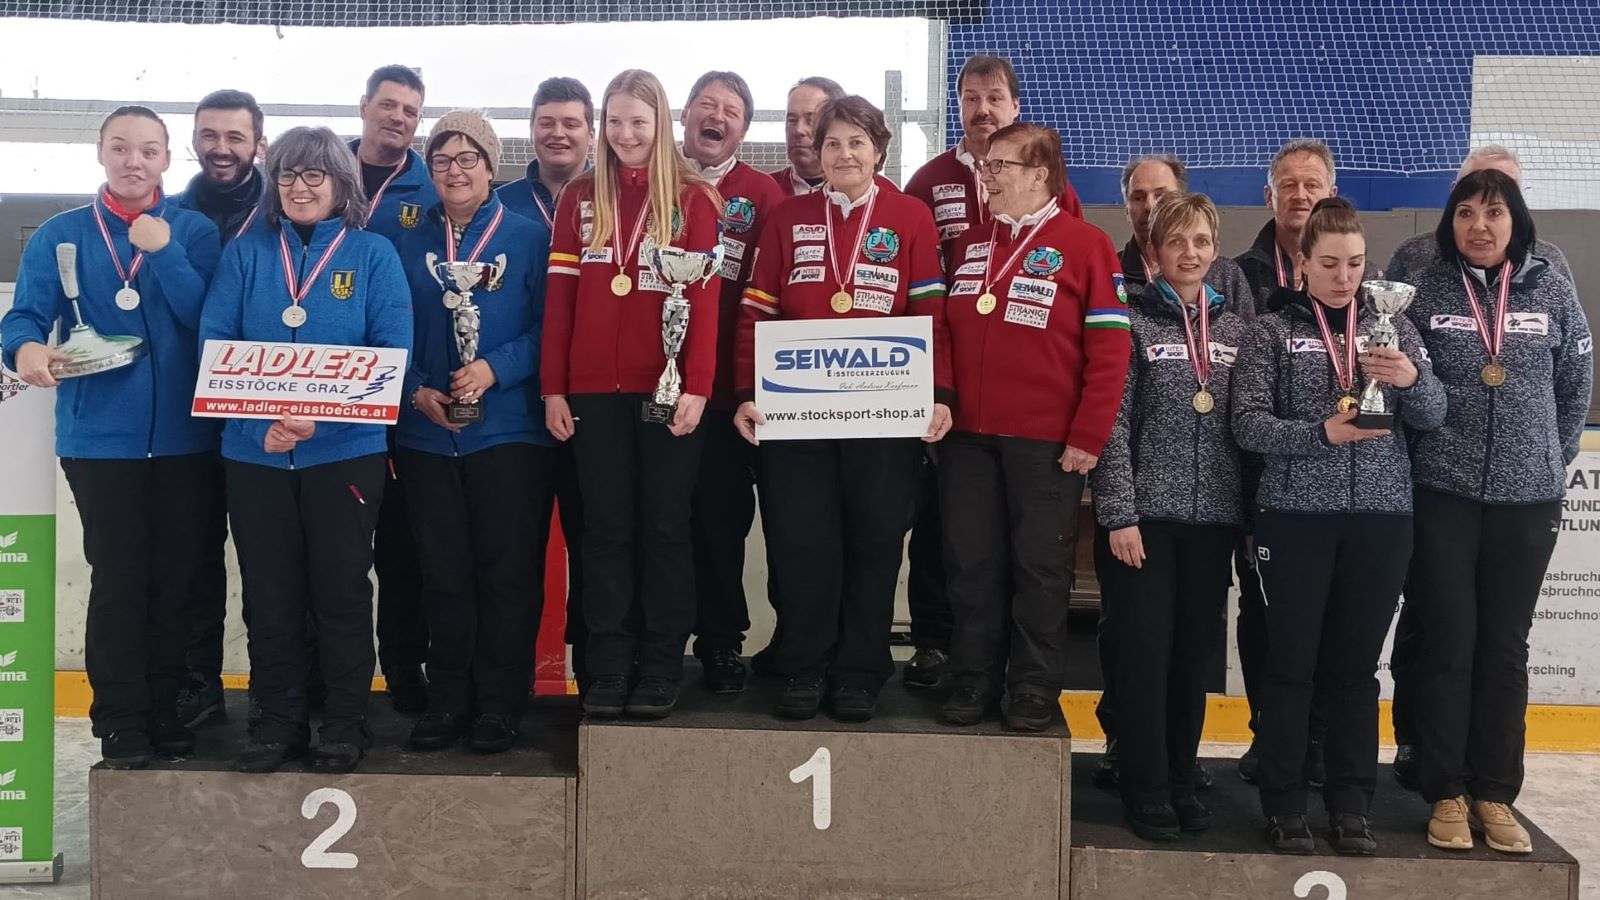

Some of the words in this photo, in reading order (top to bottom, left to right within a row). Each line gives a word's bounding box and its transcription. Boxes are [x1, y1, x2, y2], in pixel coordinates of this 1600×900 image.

[209, 344, 378, 381] LADLER
[774, 347, 911, 371] SEIWALD
[208, 378, 298, 392] EISSTÖCKE
[306, 383, 350, 394] GRAZ
[206, 400, 388, 418] www.ladler-eisstoecke.at
[765, 407, 926, 422] www.stocksport-shop.at
[1566, 469, 1600, 490] AT
[789, 746, 831, 830] 1
[301, 787, 359, 868] 2
